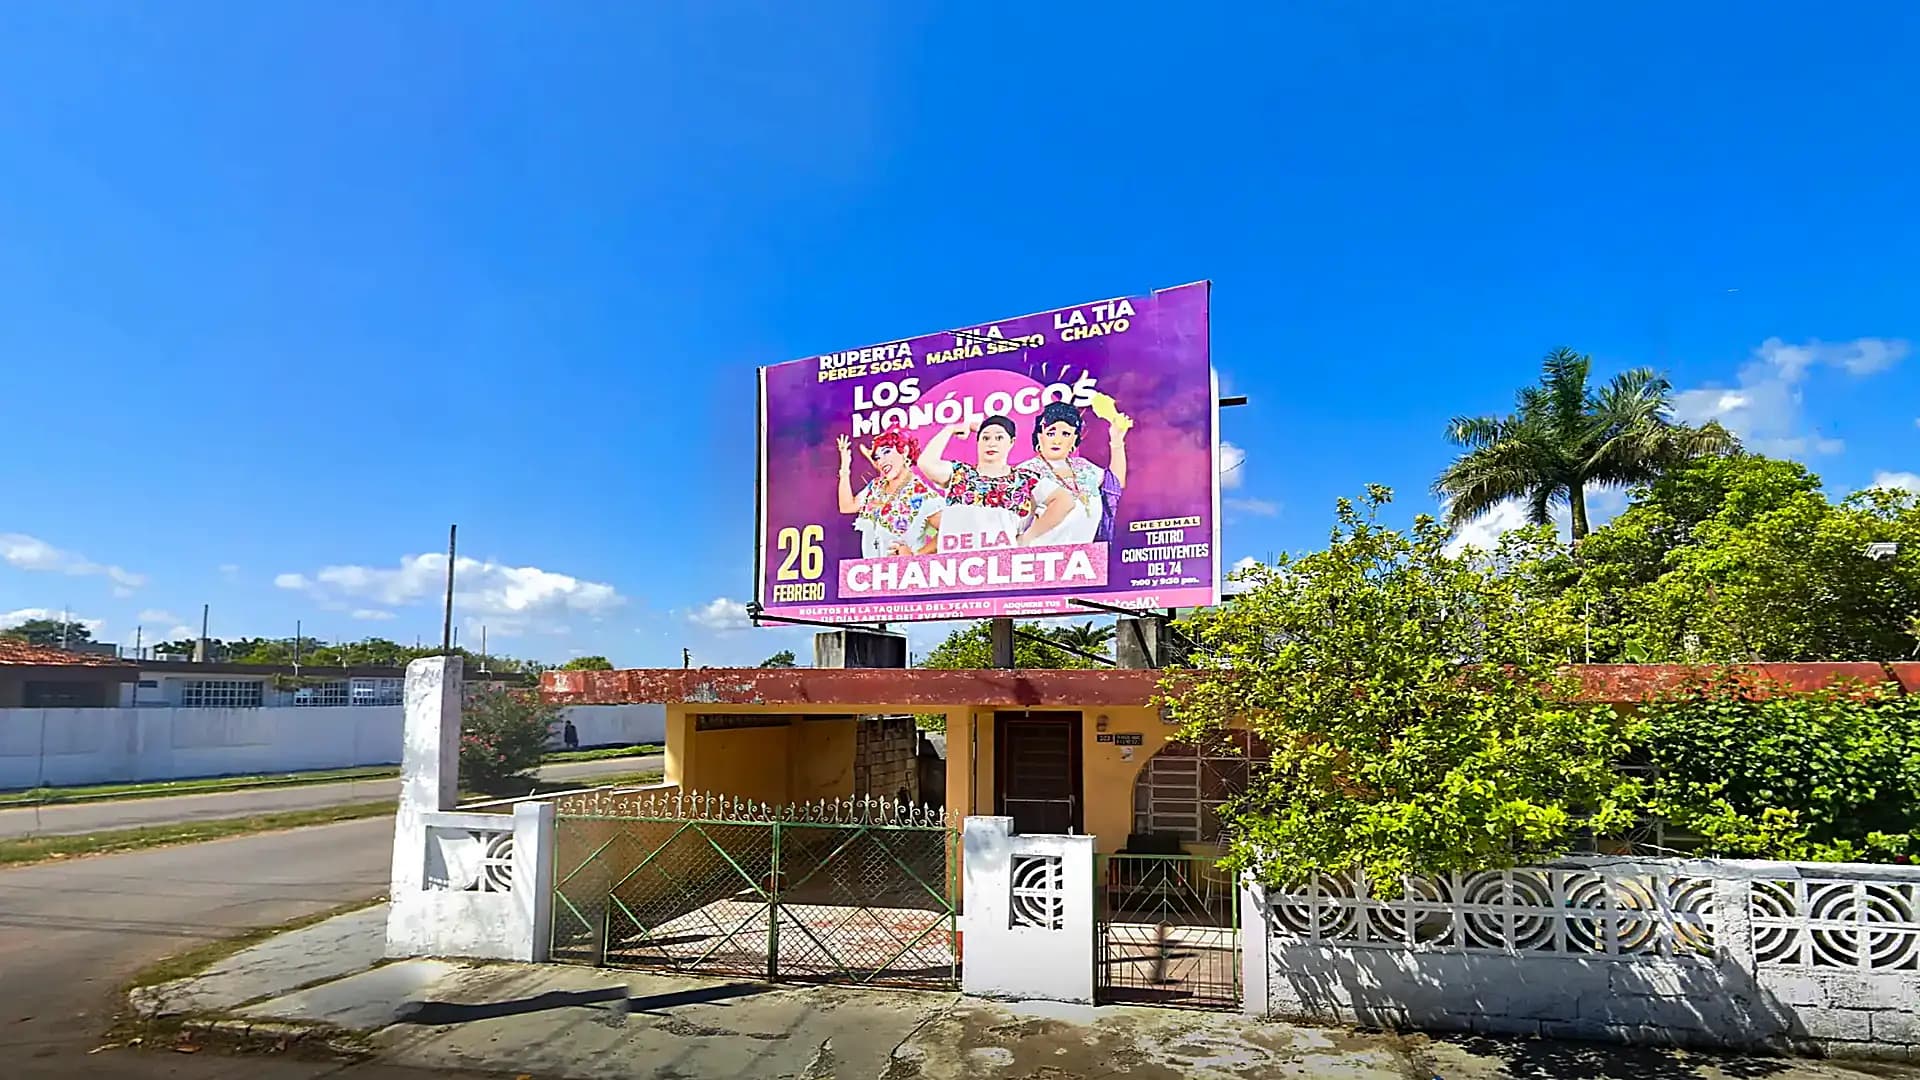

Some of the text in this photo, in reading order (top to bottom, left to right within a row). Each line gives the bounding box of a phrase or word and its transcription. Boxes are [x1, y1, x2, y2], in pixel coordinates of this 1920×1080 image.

[1054, 300, 1135, 329] LA TÍA
[1061, 319, 1130, 341] CHAYO
[819, 342, 912, 370] RUPERTA
[926, 343, 984, 365] MARÍA
[818, 357, 915, 383] PÉREZ SOSA
[854, 377, 921, 410] LOS
[852, 378, 1098, 438] MONÓLOGOS
[1132, 518, 1198, 529] CHETUMAL
[943, 530, 1011, 550] DE LA
[1145, 529, 1184, 545] TEATRO
[777, 524, 824, 581] 26
[1121, 543, 1209, 562] CONSTITUYENTES
[846, 551, 1097, 592] CHANCLETA
[1147, 561, 1182, 576] DEL 74
[773, 582, 825, 602] FEBRERO
[873, 604, 923, 613] TAQUILLA
[925, 603, 946, 611] DEL
[949, 601, 991, 610] TEATRO
